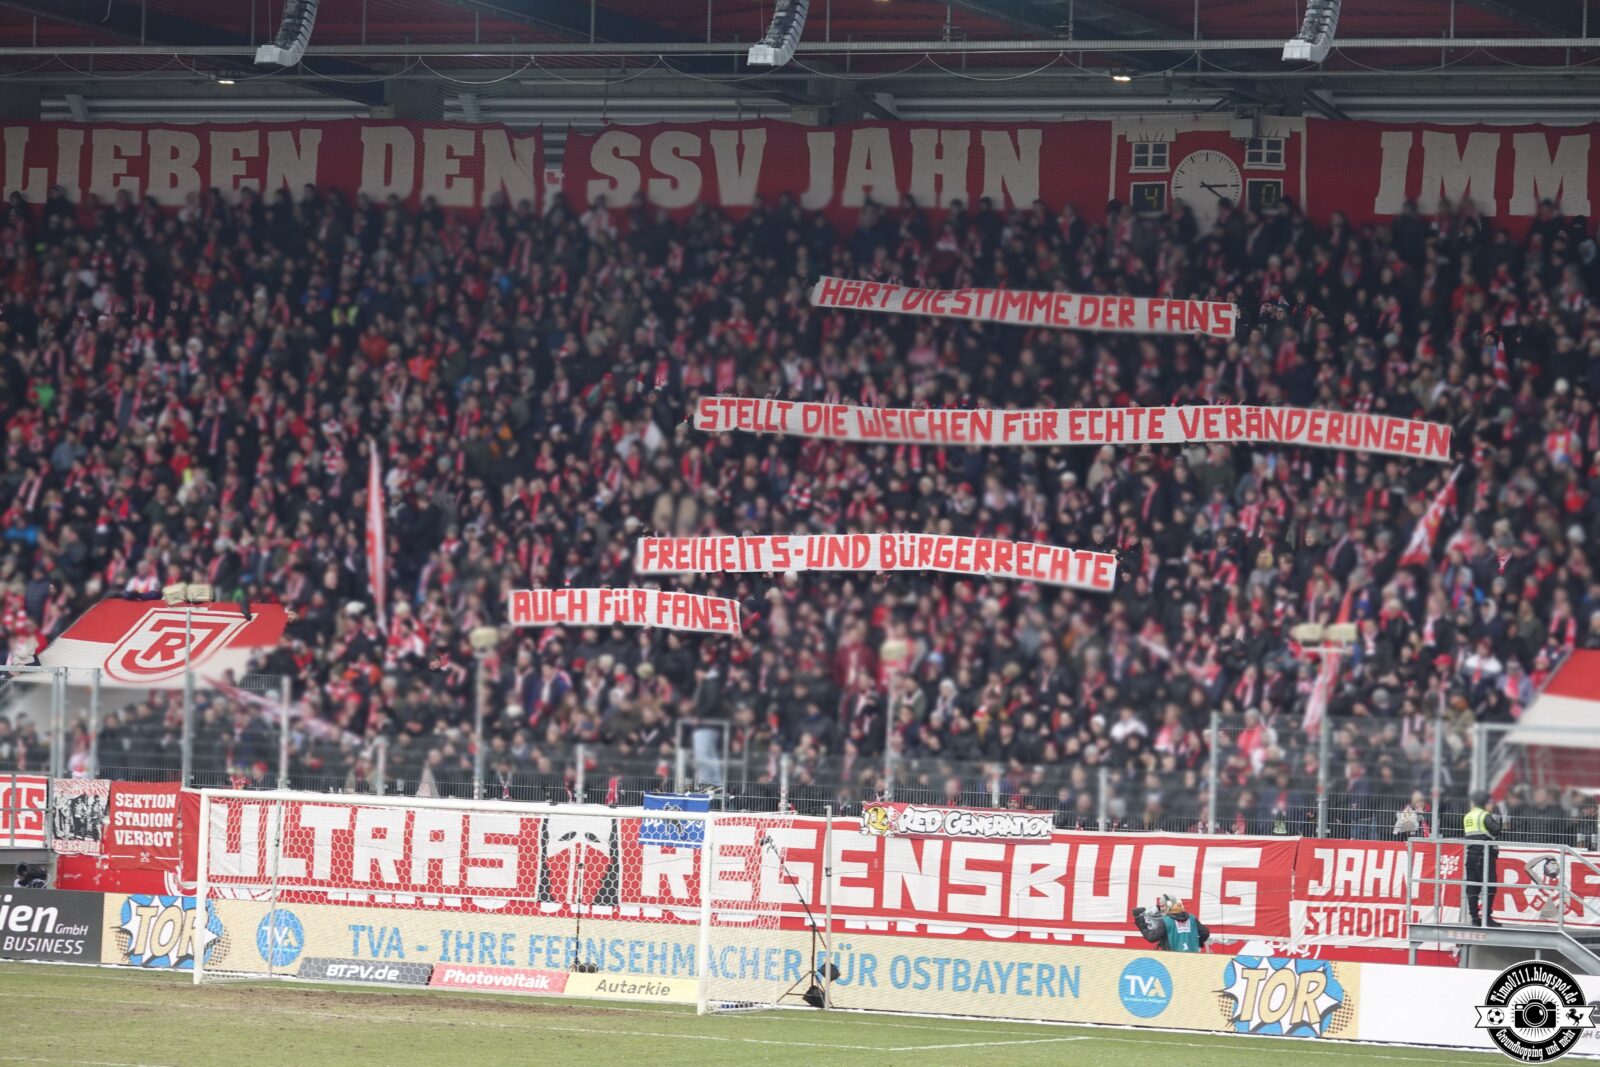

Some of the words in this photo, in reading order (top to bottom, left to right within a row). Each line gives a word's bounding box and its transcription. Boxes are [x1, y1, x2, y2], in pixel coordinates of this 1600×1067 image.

[3, 126, 323, 206] LIEBEN
[358, 126, 536, 209] DEN
[587, 128, 767, 208] SSV
[800, 127, 1043, 209] JAHN
[1374, 131, 1591, 216] IMM
[819, 277, 899, 309] HÖRT
[1077, 294, 1136, 329] DER
[1148, 300, 1233, 335] FANS
[699, 397, 793, 431] STELLT
[802, 403, 850, 437] DIE
[856, 407, 993, 442] WEICHEN
[1003, 410, 1059, 442] FÜR
[1068, 408, 1167, 442] ECHTE
[1178, 406, 1451, 457] VERÄNDERUNGEN
[880, 533, 1115, 589] BÜRGERRECHTE
[512, 589, 588, 624] AUCH
[599, 591, 647, 624] FÜR
[657, 592, 740, 633] FANS!
[115, 793, 176, 809] SEKTION
[115, 811, 174, 827] STADION
[114, 831, 174, 847] VERBOT
[900, 806, 943, 834] RED
[944, 810, 1055, 838] GENERATION
[208, 802, 520, 889] ULTRAS
[641, 826, 1261, 927] REGENSBURG
[1307, 848, 1424, 899] JAHN
[0, 894, 58, 933] ien
[55, 923, 88, 935] GmbH
[134, 904, 208, 959] TOR
[3, 936, 85, 954] BUSINESS
[262, 925, 299, 948] TVA
[327, 964, 399, 981] BTPV.de
[348, 924, 404, 959] TVA
[439, 929, 516, 966] IHRE
[890, 954, 1080, 999] OSTBAYERN
[444, 969, 550, 990] Photovoltaik
[595, 979, 671, 996] Autarkie
[1124, 975, 1166, 998] TVA
[1240, 967, 1328, 1026] TOR
